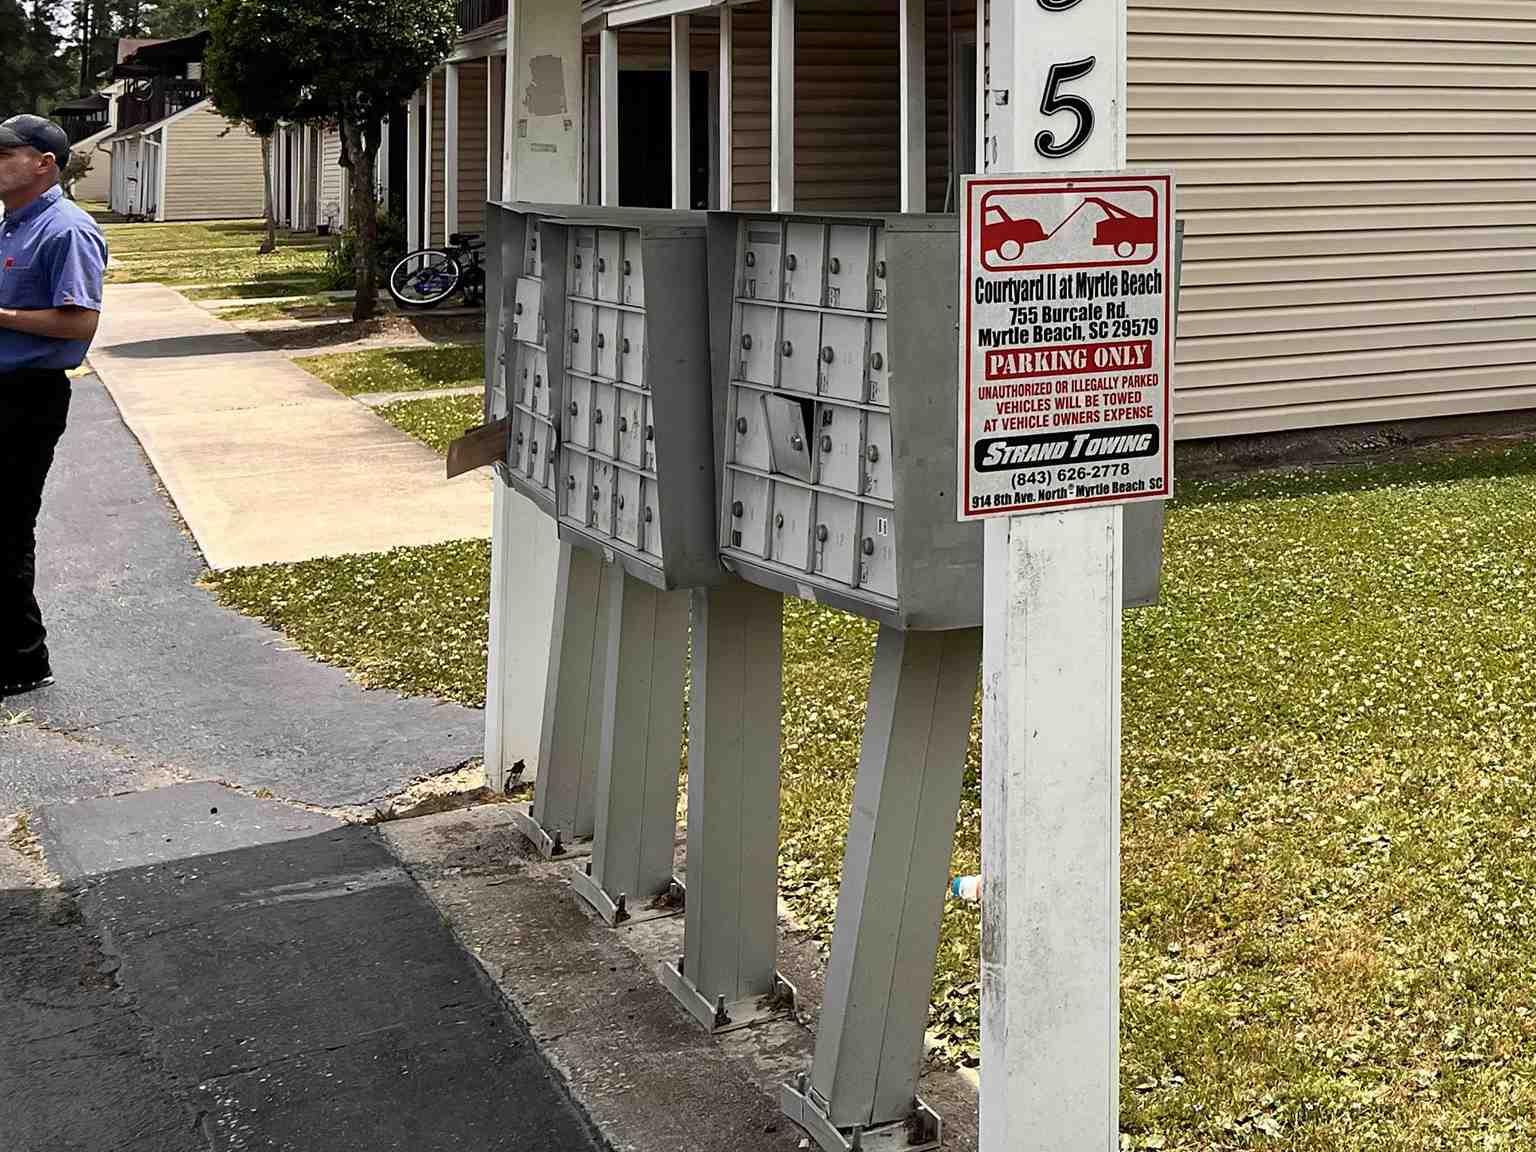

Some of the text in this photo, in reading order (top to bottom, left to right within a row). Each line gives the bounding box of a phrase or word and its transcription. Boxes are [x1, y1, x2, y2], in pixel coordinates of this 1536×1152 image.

[975, 269, 1162, 305] Courtyard II at Myrtle Beach
[1009, 301, 1129, 326] 755 Burcale Rd.
[978, 317, 1158, 348] Myrtle Beach, SC 29579
[989, 345, 1148, 376] PARKING ONLY
[978, 373, 1159, 401] UNAUTHORIZED OR ILLEGALLY PARKED
[996, 391, 1142, 416] VEHICLES WILL BE TOWED
[983, 405, 1153, 433] AT VEHICLE OWNERS EXPENSE
[982, 433, 1152, 467] STRAND TOWING
[1011, 463, 1130, 490] (843) 626-2778
[972, 494, 992, 509] 914
[993, 491, 1012, 506] 8th
[1013, 490, 1036, 504] Ave.
[1038, 486, 1067, 500] North
[1076, 483, 1109, 499] Myrtle
[1112, 479, 1145, 494] Beach
[1149, 477, 1162, 490] SC
